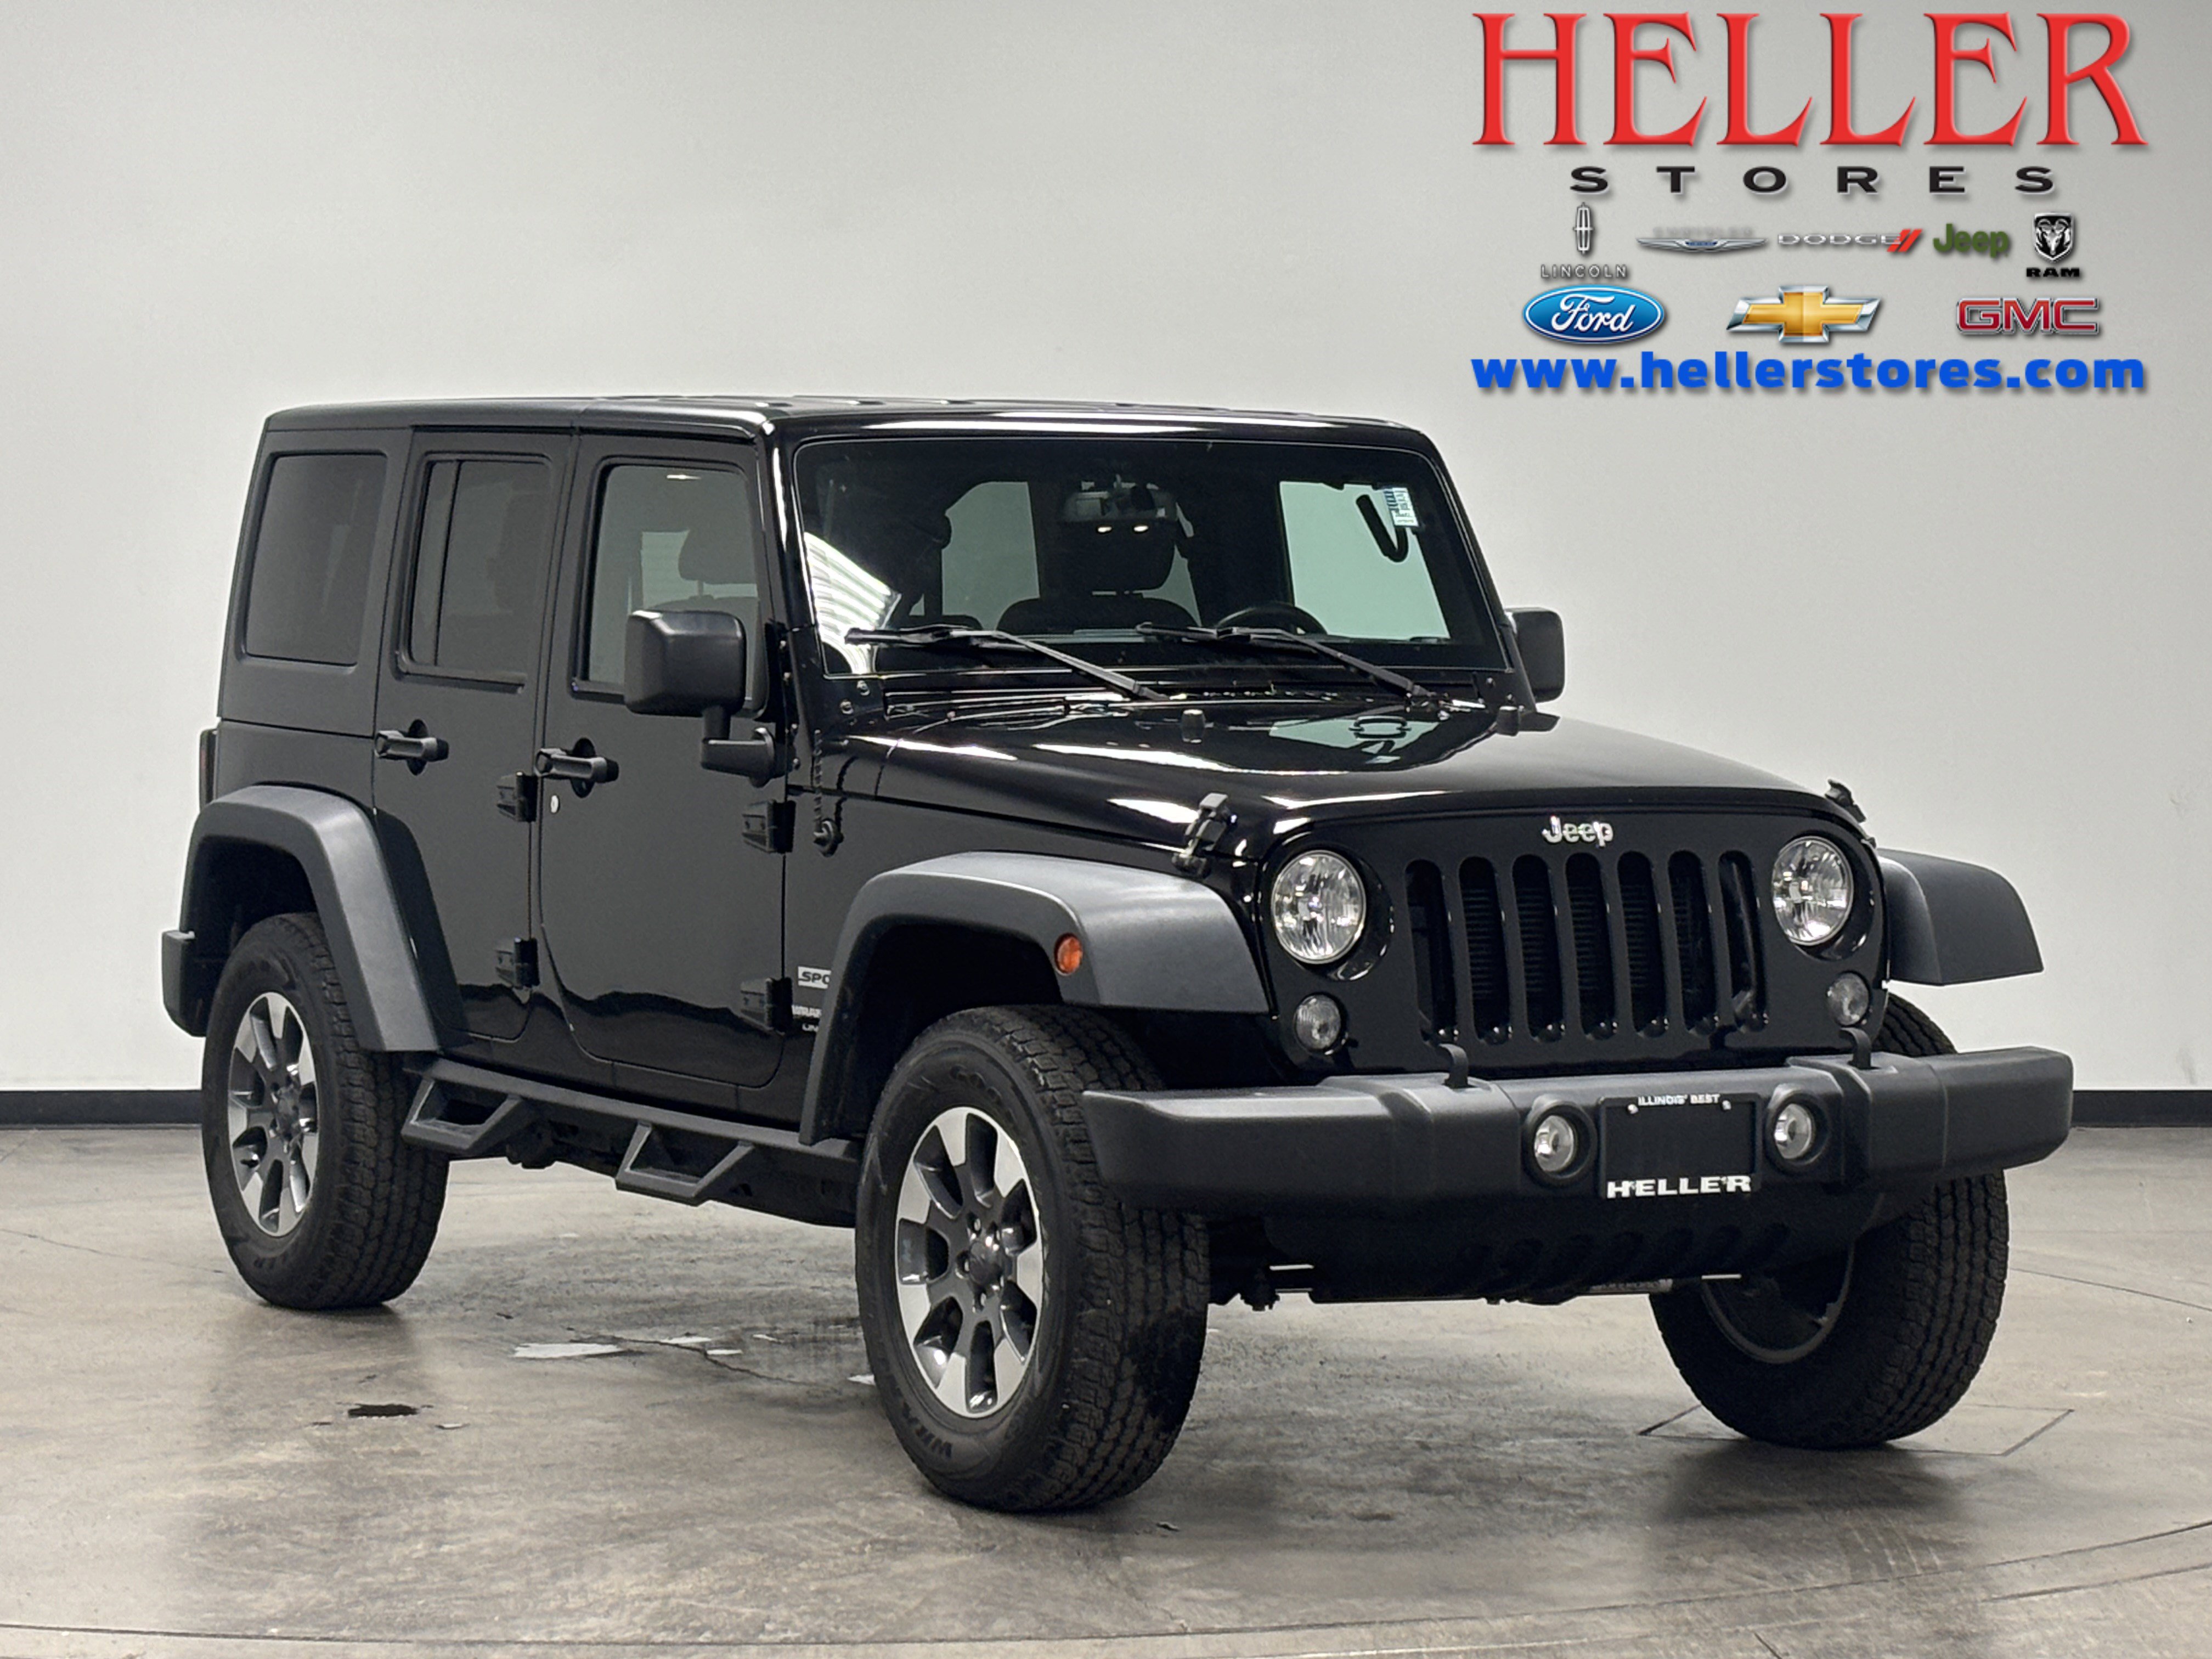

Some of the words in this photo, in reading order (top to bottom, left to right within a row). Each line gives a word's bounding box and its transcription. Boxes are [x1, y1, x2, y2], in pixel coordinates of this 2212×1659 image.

[1542, 816, 1613, 847] Jeep
[799, 972, 830, 985] SPO
[1690, 1093, 1720, 1104] BEST
[1607, 1176, 1751, 1198] HELLER
